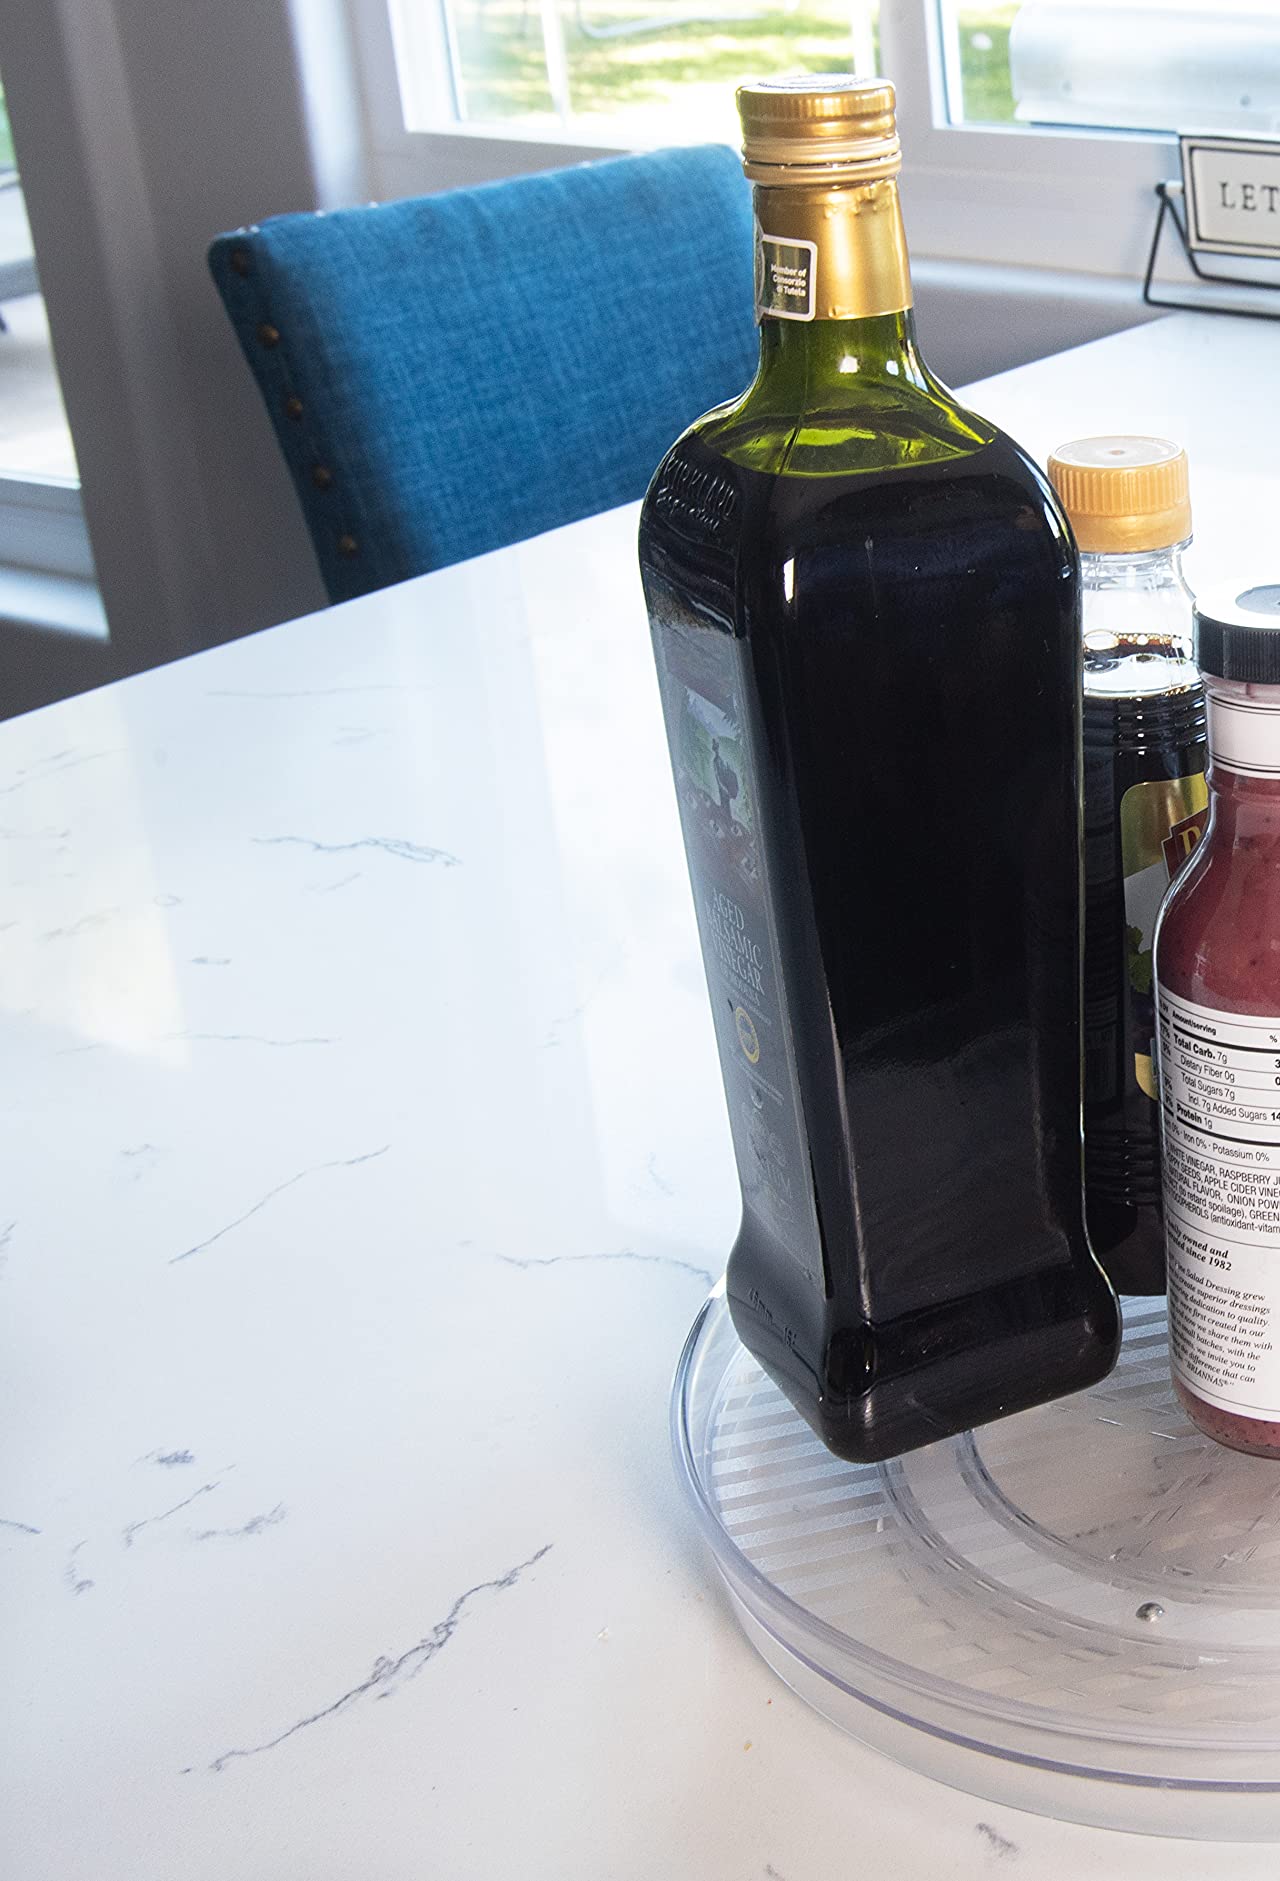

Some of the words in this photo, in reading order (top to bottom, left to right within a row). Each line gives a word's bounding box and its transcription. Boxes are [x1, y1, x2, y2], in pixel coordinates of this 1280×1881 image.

[1174, 1034, 1191, 1051] Total
[1193, 1043, 1216, 1060] Carb.
[1217, 1051, 1228, 1064] 7g
[1270, 1035, 1278, 1043] %
[1180, 1054, 1203, 1075] Dietary
[1203, 1064, 1223, 1079] Fiber
[1224, 1071, 1235, 1083] 0g
[1180, 1071, 1197, 1087] Total
[1197, 1080, 1224, 1098] Sugars
[1224, 1089, 1235, 1101] 7g
[1176, 1103, 1202, 1124] Protein
[1204, 1117, 1213, 1130] 1g
[1202, 1099, 1211, 1112] 7g
[1212, 1104, 1237, 1117] Added
[1238, 1108, 1268, 1122] Sugars
[1195, 1137, 1207, 1150] 0%
[1212, 1142, 1254, 1160] Potassium
[1255, 1151, 1270, 1162] 0%
[1185, 1152, 1218, 1177] VINEGAR,
[1219, 1167, 1271, 1184] RASPBERRY
[1192, 1181, 1223, 1201] FLAVOR,
[1226, 1192, 1255, 1207] ONION
[1204, 1175, 1228, 1191] APPLE
[1230, 1182, 1257, 1196] CIDER
[1187, 1191, 1207, 1207] retard
[1208, 1200, 1247, 1219] spoilage),
[1249, 1210, 1280, 1222] GREEN
[1183, 1233, 1208, 1252] owned
[1209, 1247, 1229, 1259] and
[1186, 1246, 1207, 1263] since
[1209, 1256, 1232, 1271] 1982
[1186, 1268, 1205, 1285] Salad
[1205, 1278, 1241, 1299] Dressing
[1242, 1293, 1266, 1302] grew
[1190, 1294, 1226, 1318] dedication
[1227, 1310, 1236, 1320] to
[1237, 1313, 1270, 1328] quality.
[1196, 1289, 1228, 1306] superior
[1229, 1299, 1271, 1315] dressings
[1207, 1318, 1237, 1333] created
[1238, 1325, 1247, 1335] in
[1249, 1330, 1266, 1338] our
[1208, 1328, 1229, 1341] share
[1231, 1337, 1251, 1348] them
[1253, 1341, 1273, 1351] with
[1196, 1333, 1225, 1353] batches,
[1227, 1346, 1246, 1359] with
[1247, 1351, 1261, 1361] the
[1188, 1351, 1221, 1374] difference
[1222, 1369, 1239, 1380] that
[1239, 1375, 1256, 1384] can
[1207, 1350, 1229, 1365] invite
[1229, 1359, 1246, 1370] you
[1247, 1362, 1256, 1372] to
